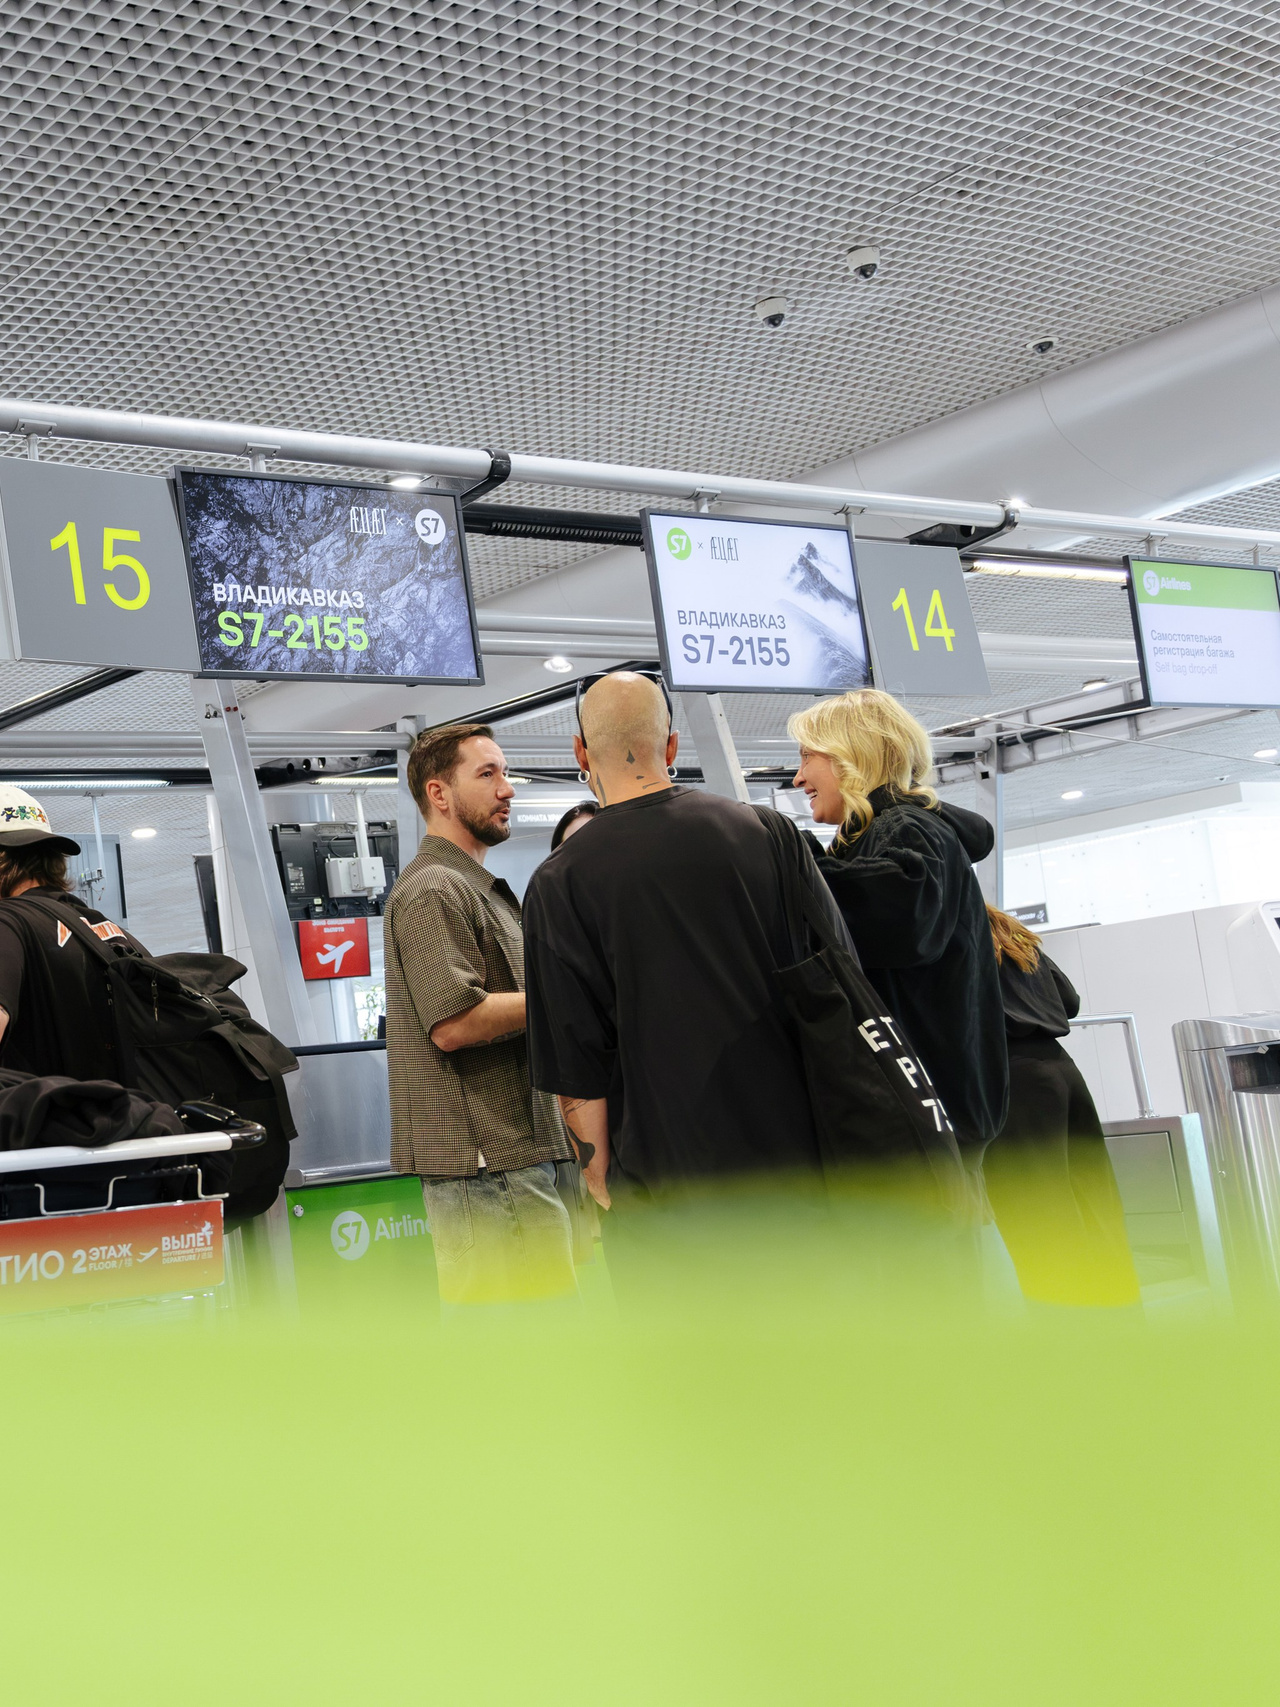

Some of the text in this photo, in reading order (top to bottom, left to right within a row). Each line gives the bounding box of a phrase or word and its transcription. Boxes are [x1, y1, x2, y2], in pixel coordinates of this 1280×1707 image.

[419, 517, 440, 538] S7
[670, 534, 687, 555] S7
[49, 521, 151, 611] 15
[213, 582, 365, 609] ВЛАДИКАВКАЗ
[677, 609, 787, 631] ВЛАДИКАВКАЗ
[891, 587, 956, 652] 14
[217, 611, 369, 651] S7-2155
[1150, 629, 1223, 644] Самостоятельная
[683, 634, 791, 667] S7-2155
[1153, 645, 1235, 658] регистрация багажа
[1172, 662, 1187, 676] bag
[337, 1214, 432, 1252] S7 Airlin
[71, 1250, 88, 1274] 2
[88, 1243, 133, 1261] ЭТАЖ
[162, 1230, 214, 1252] ВЫЛЕТ
[162, 1253, 196, 1264] DEPARTURE
[88, 1260, 117, 1271] FLOOR
